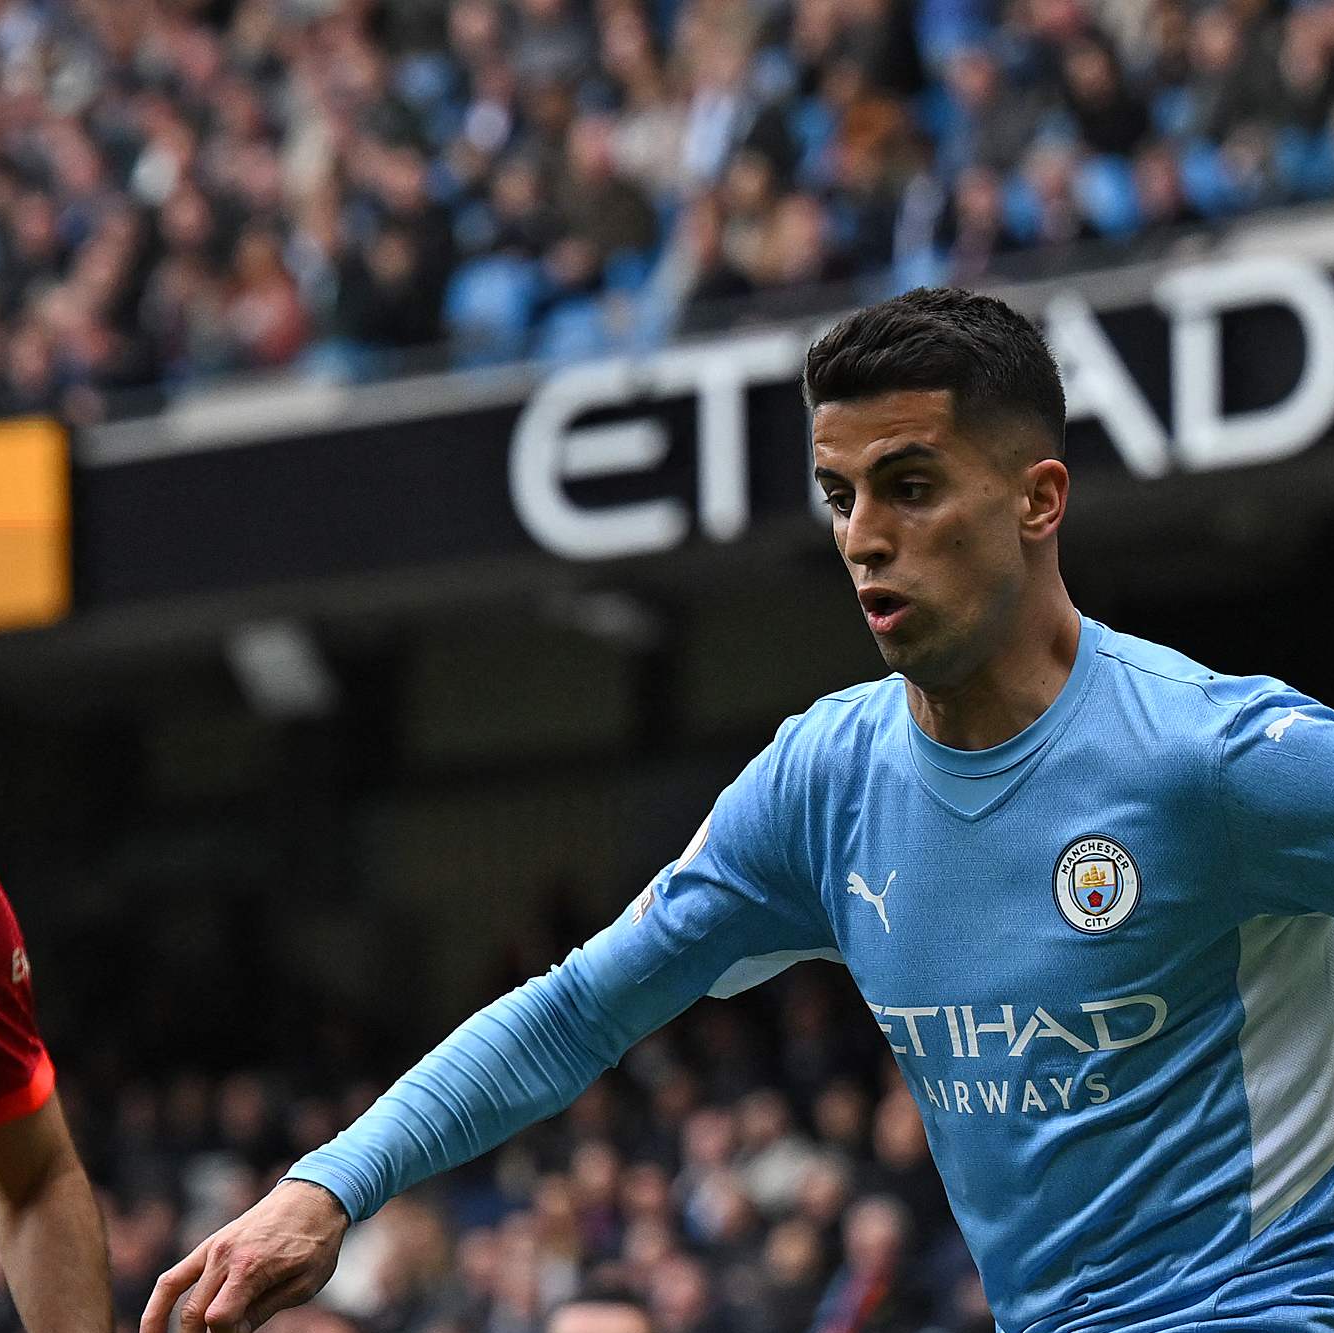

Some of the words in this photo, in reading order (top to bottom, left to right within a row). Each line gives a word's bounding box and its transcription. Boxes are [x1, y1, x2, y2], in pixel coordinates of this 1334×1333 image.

[1061, 842, 1130, 874] MANCHESTER
[1084, 917, 1110, 927] CITY
[922, 1073, 1110, 1114] AIRWAYS
